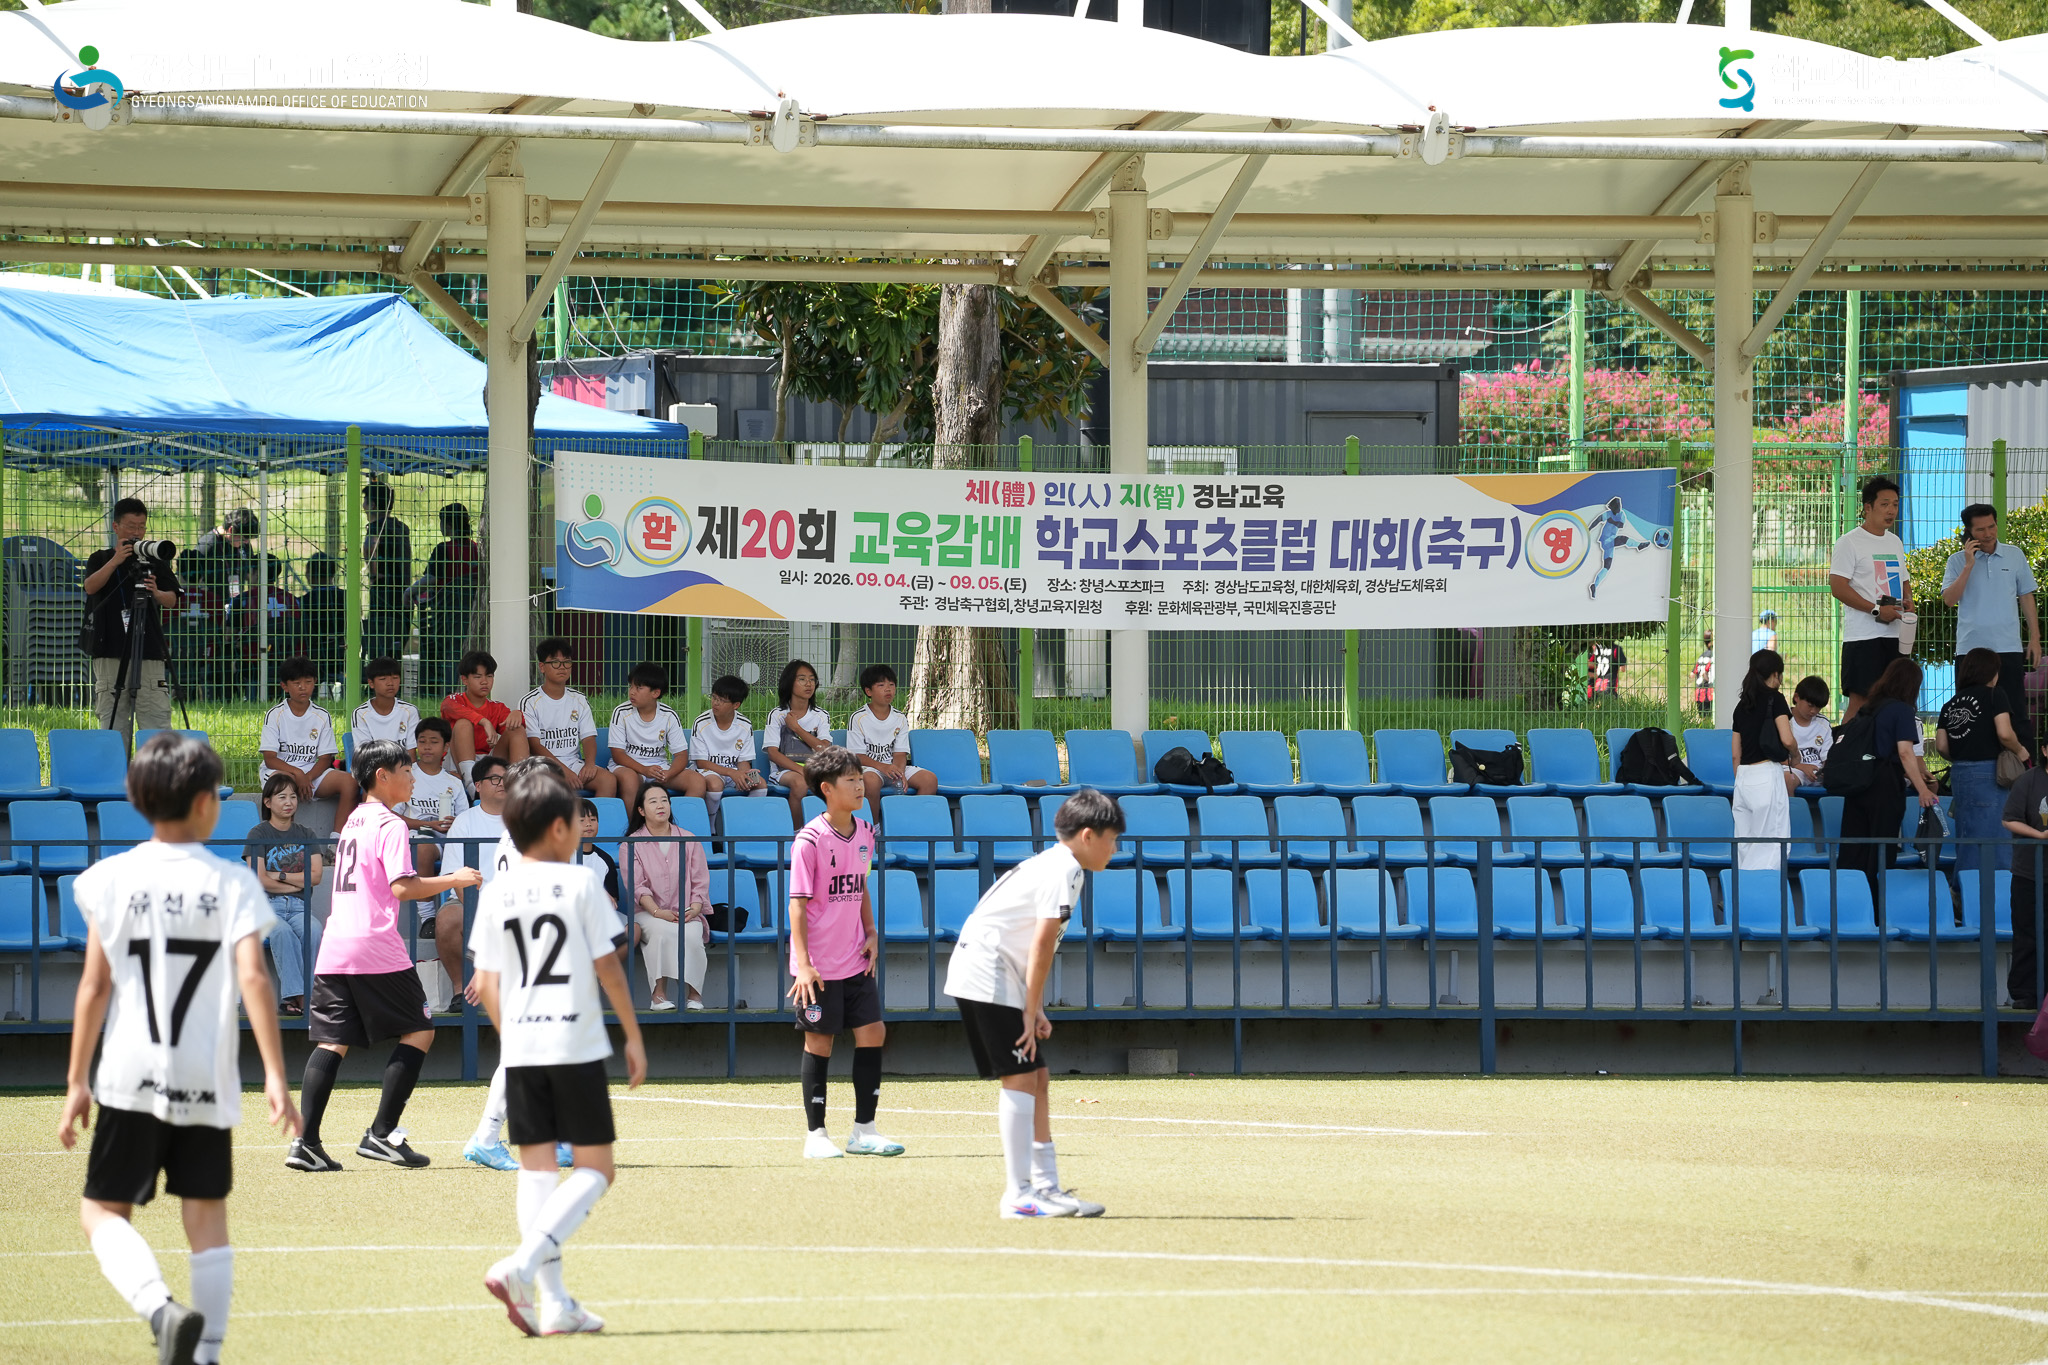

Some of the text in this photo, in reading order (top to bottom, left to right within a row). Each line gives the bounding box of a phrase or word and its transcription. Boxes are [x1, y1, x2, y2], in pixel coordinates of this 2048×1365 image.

[965, 479, 1285, 511] 체(體) 인(人) 지(智) 경남교육
[642, 512, 677, 551] 환
[695, 505, 1523, 572] 제20회 교육감배 학교스포츠클럽 대회(축구)
[1543, 527, 1573, 563] 영
[779, 569, 808, 586] 일시:
[1047, 578, 1165, 594] 장소: 창녕스포츠파크
[1182, 577, 1448, 596] 주최: 경상남도교육청, 대한체육회, 경상남도체육회
[899, 595, 929, 611] 주관:
[1124, 600, 1337, 616] 후원: 문화체육관광부, 국민체육진흥공단
[335, 838, 357, 892] 12
[830, 855, 836, 868] 4
[828, 895, 853, 903] SPORTS
[503, 913, 571, 988] 12
[128, 937, 222, 1047] 17
